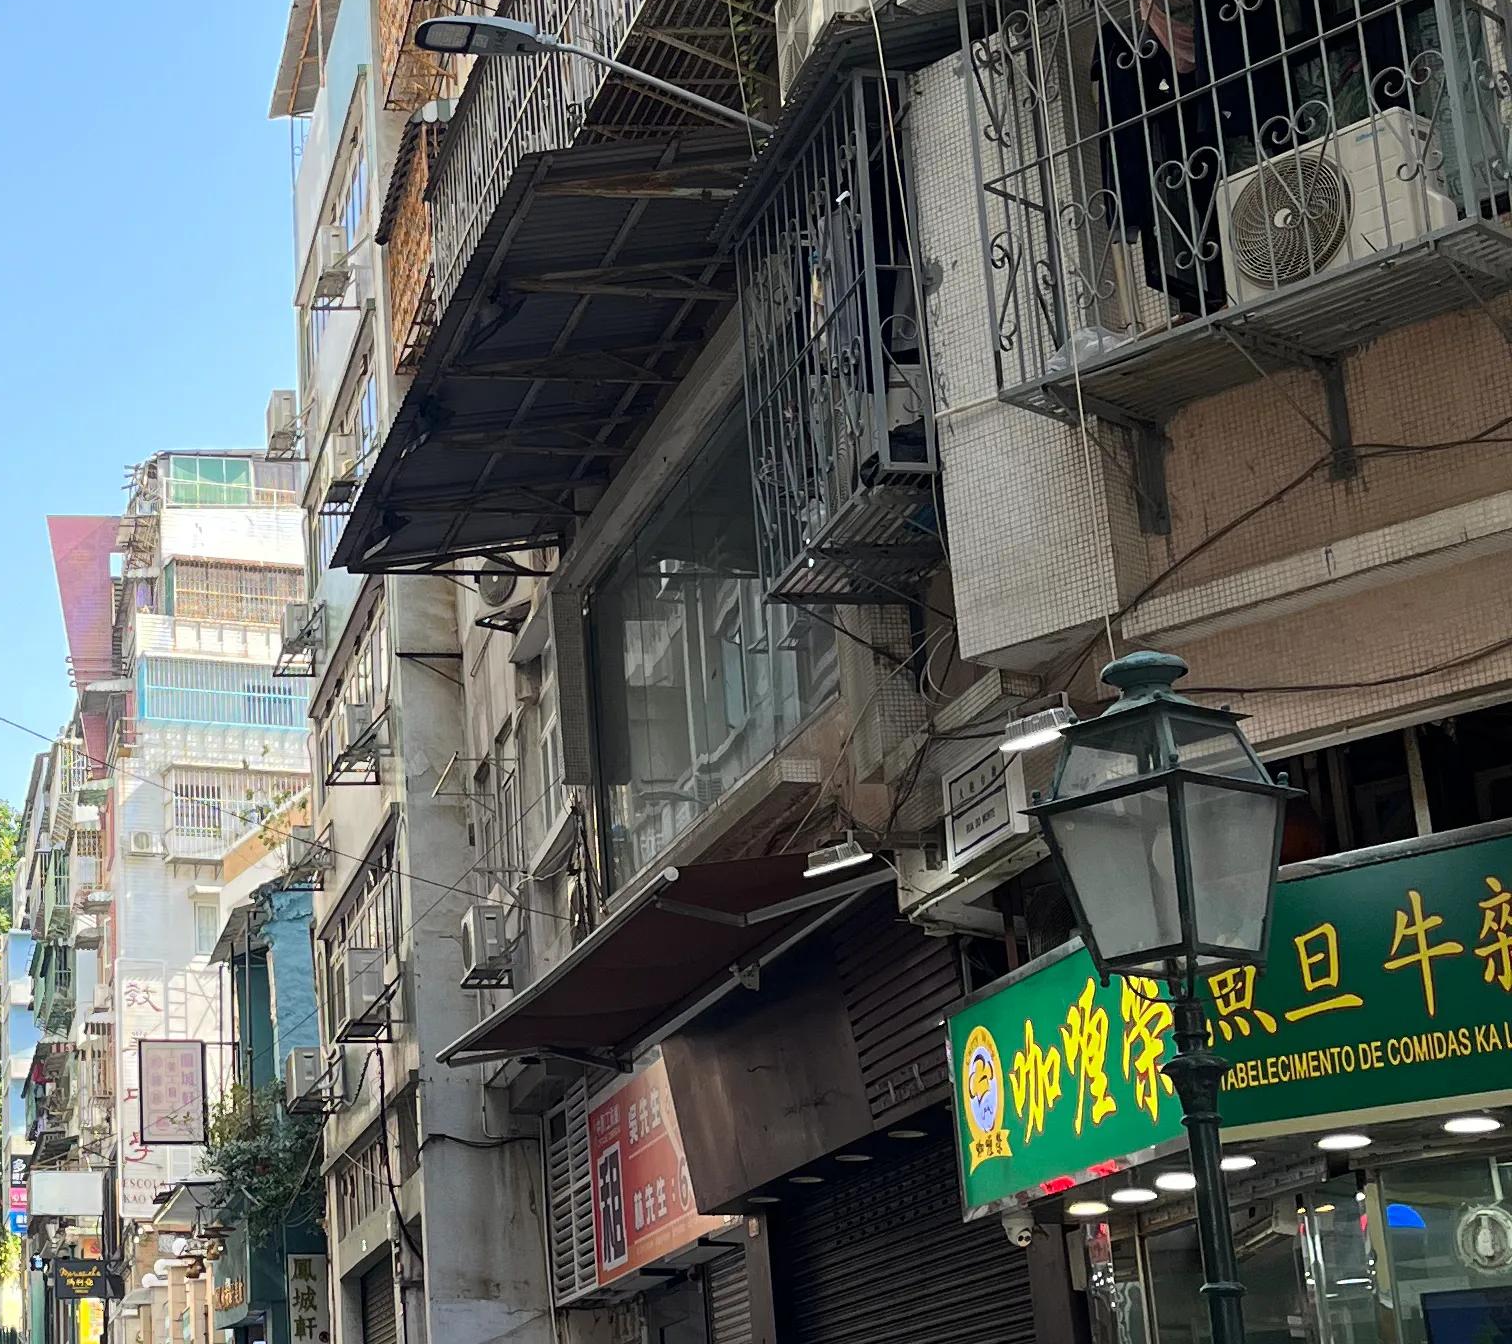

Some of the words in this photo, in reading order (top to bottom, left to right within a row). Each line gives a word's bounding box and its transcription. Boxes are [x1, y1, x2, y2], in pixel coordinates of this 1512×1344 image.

[1358, 1040, 1385, 1070] DE
[1387, 1027, 1472, 1067] COMIDAS
[1474, 1022, 1503, 1053] KA
